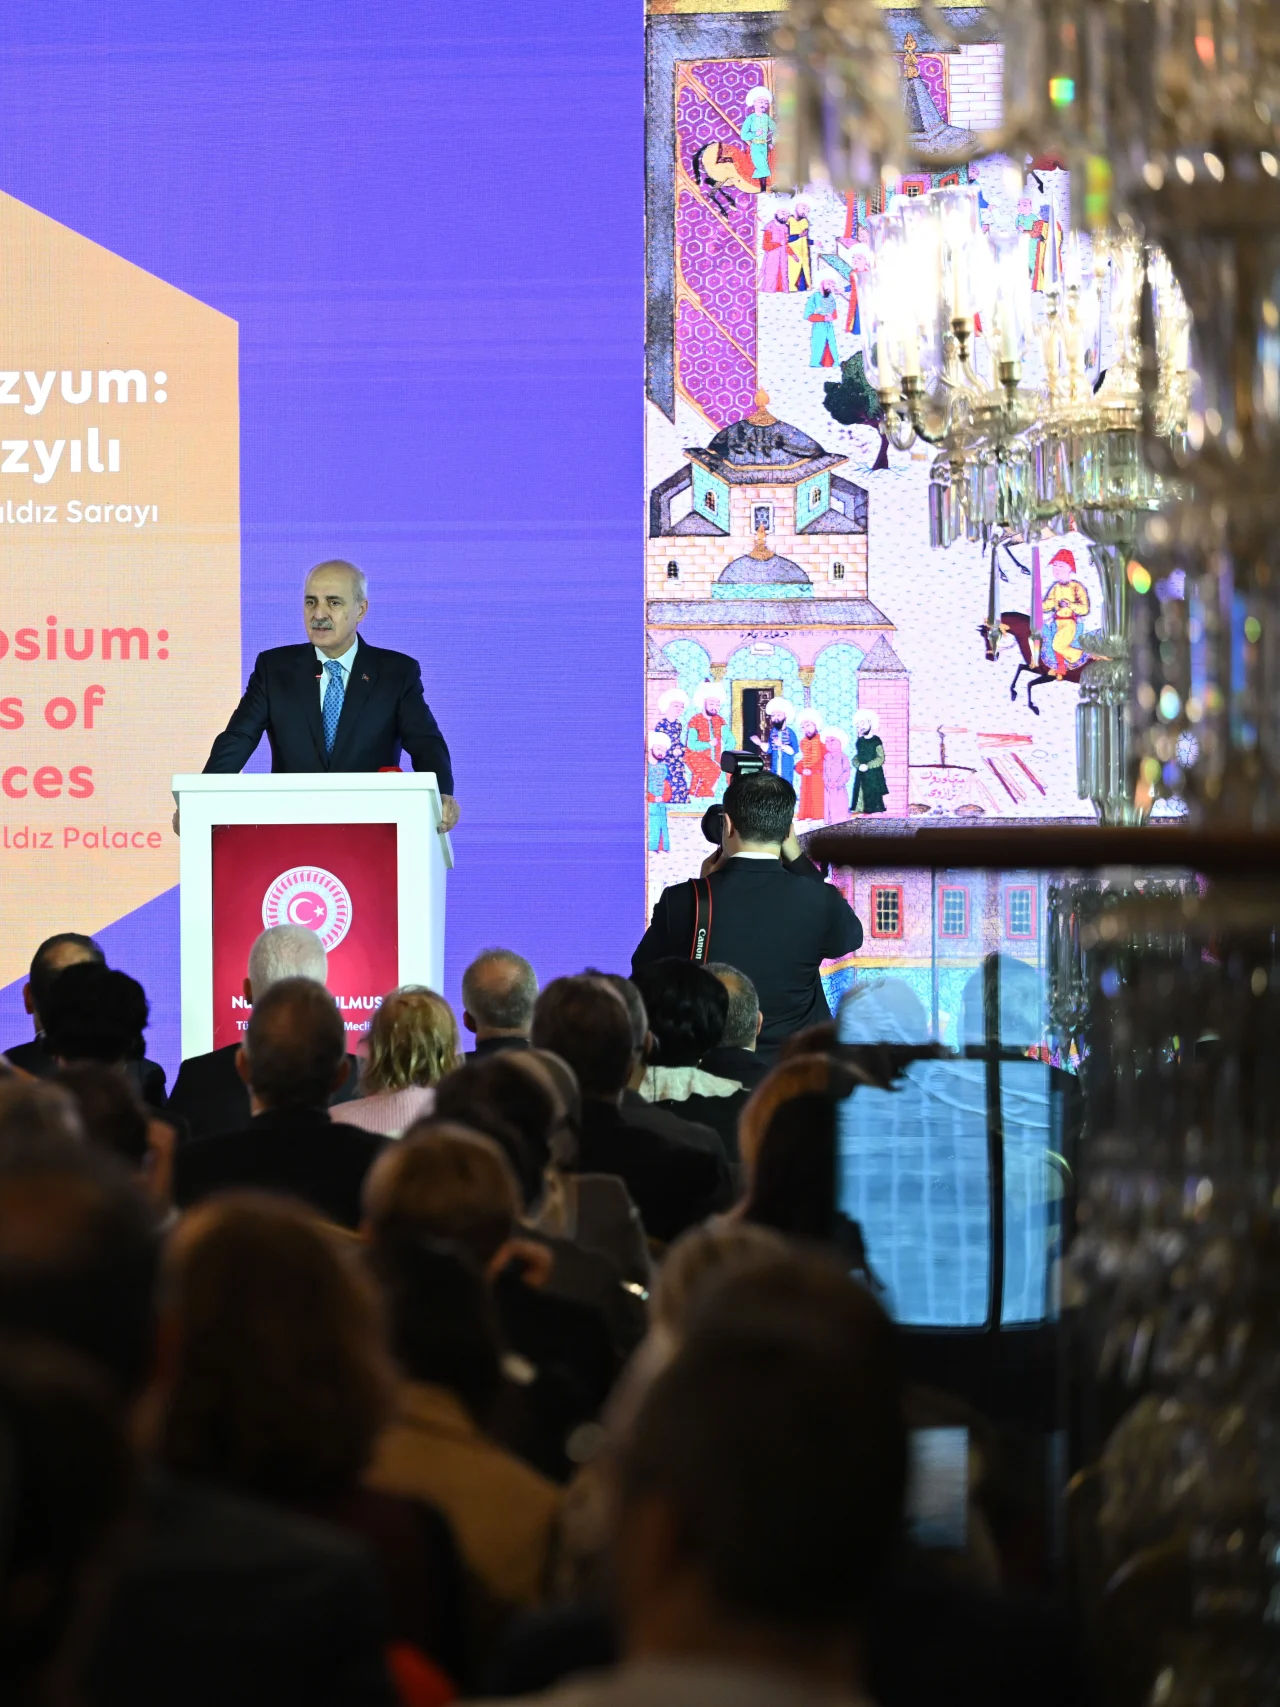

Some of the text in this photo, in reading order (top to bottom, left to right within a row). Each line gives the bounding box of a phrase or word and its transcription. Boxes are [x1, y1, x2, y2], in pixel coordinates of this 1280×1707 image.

[66, 500, 158, 529] Sarayı
[44, 684, 106, 730] of
[63, 825, 162, 850] Palace
[695, 928, 706, 960] Canon
